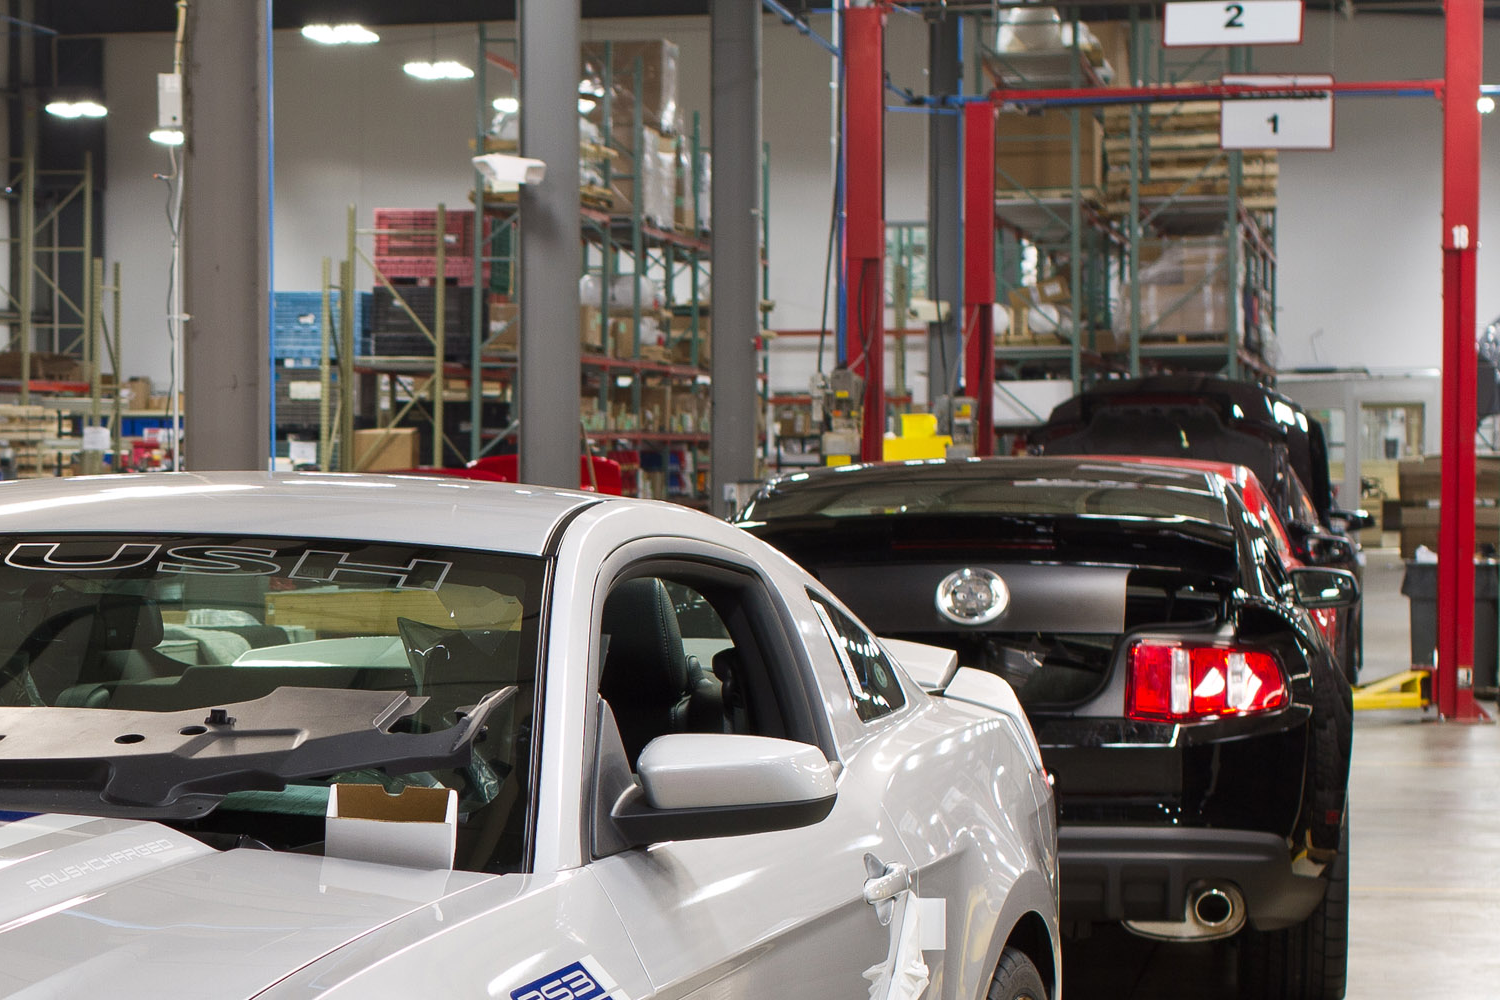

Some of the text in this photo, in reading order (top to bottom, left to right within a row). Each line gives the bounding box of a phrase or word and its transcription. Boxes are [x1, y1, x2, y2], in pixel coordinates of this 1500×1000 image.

[1223, 4, 1244, 28] 2
[1266, 113, 1280, 134] 1
[26, 838, 174, 892] ROUSHCHARGED
